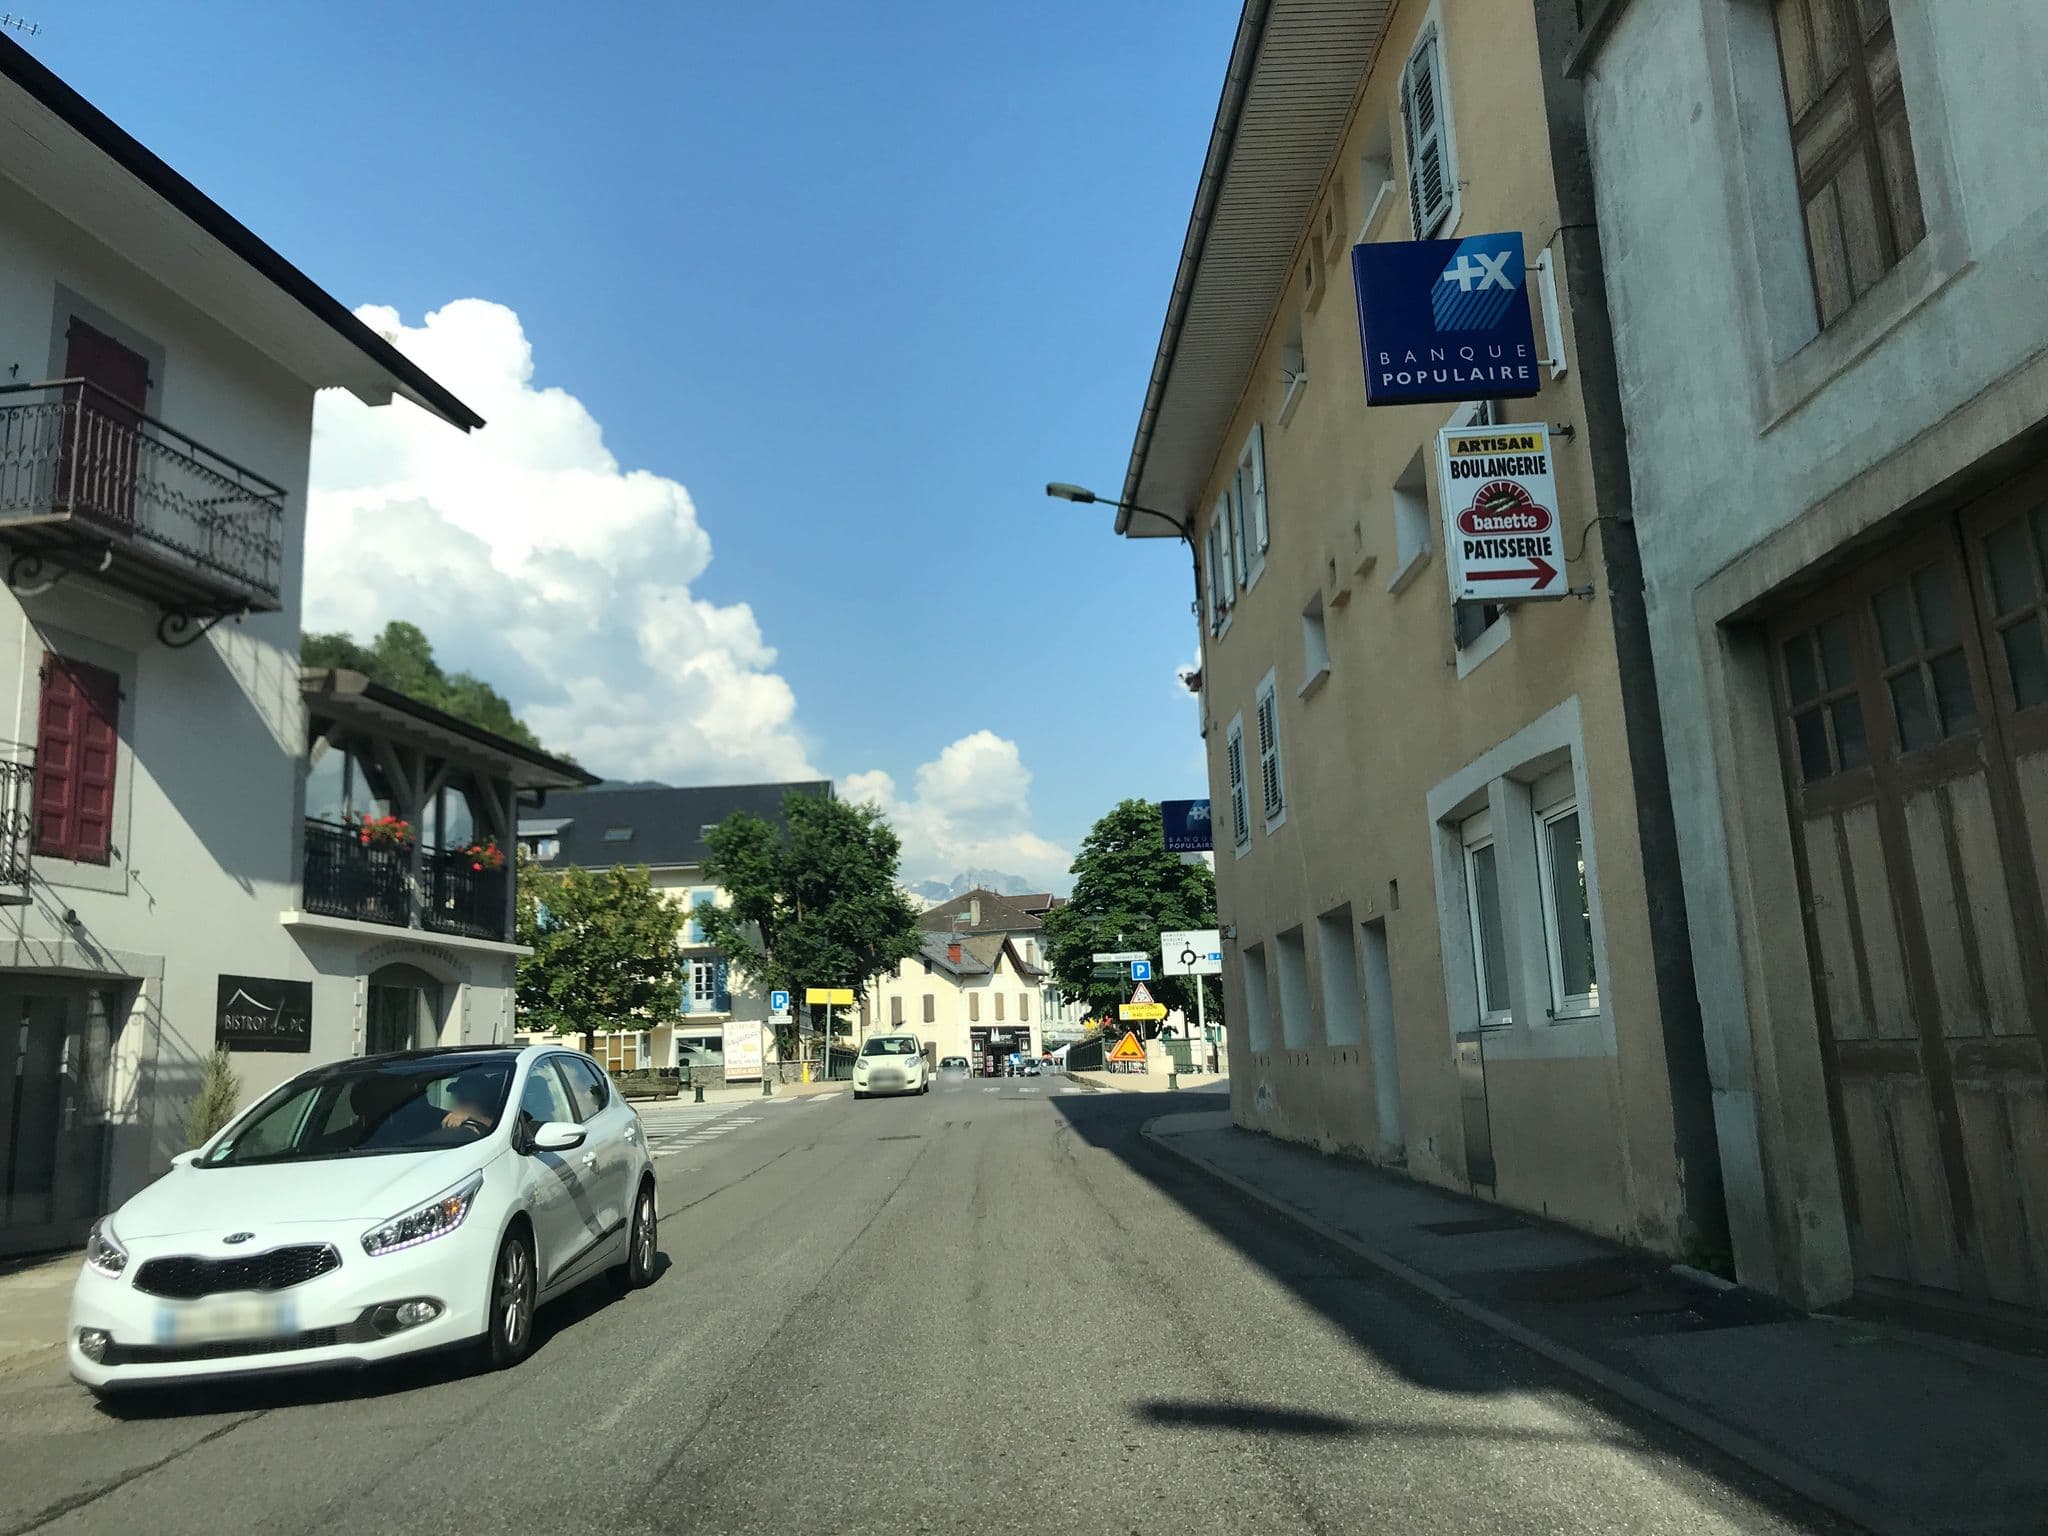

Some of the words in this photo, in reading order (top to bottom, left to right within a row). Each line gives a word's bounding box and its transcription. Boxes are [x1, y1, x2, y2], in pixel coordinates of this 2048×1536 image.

[1380, 344, 1527, 366] BANQUE
[1382, 366, 1530, 387] POPULAIRE
[1457, 436, 1534, 453] ARTISAN
[1450, 455, 1547, 480] BOULANGERIE
[1472, 513, 1538, 532] banette
[1463, 536, 1553, 560] PATISSERIE
[1168, 836, 1212, 844] BANQU
[1136, 964, 1146, 977] P
[775, 994, 785, 1007] P
[224, 1014, 269, 1032] BISTROT
